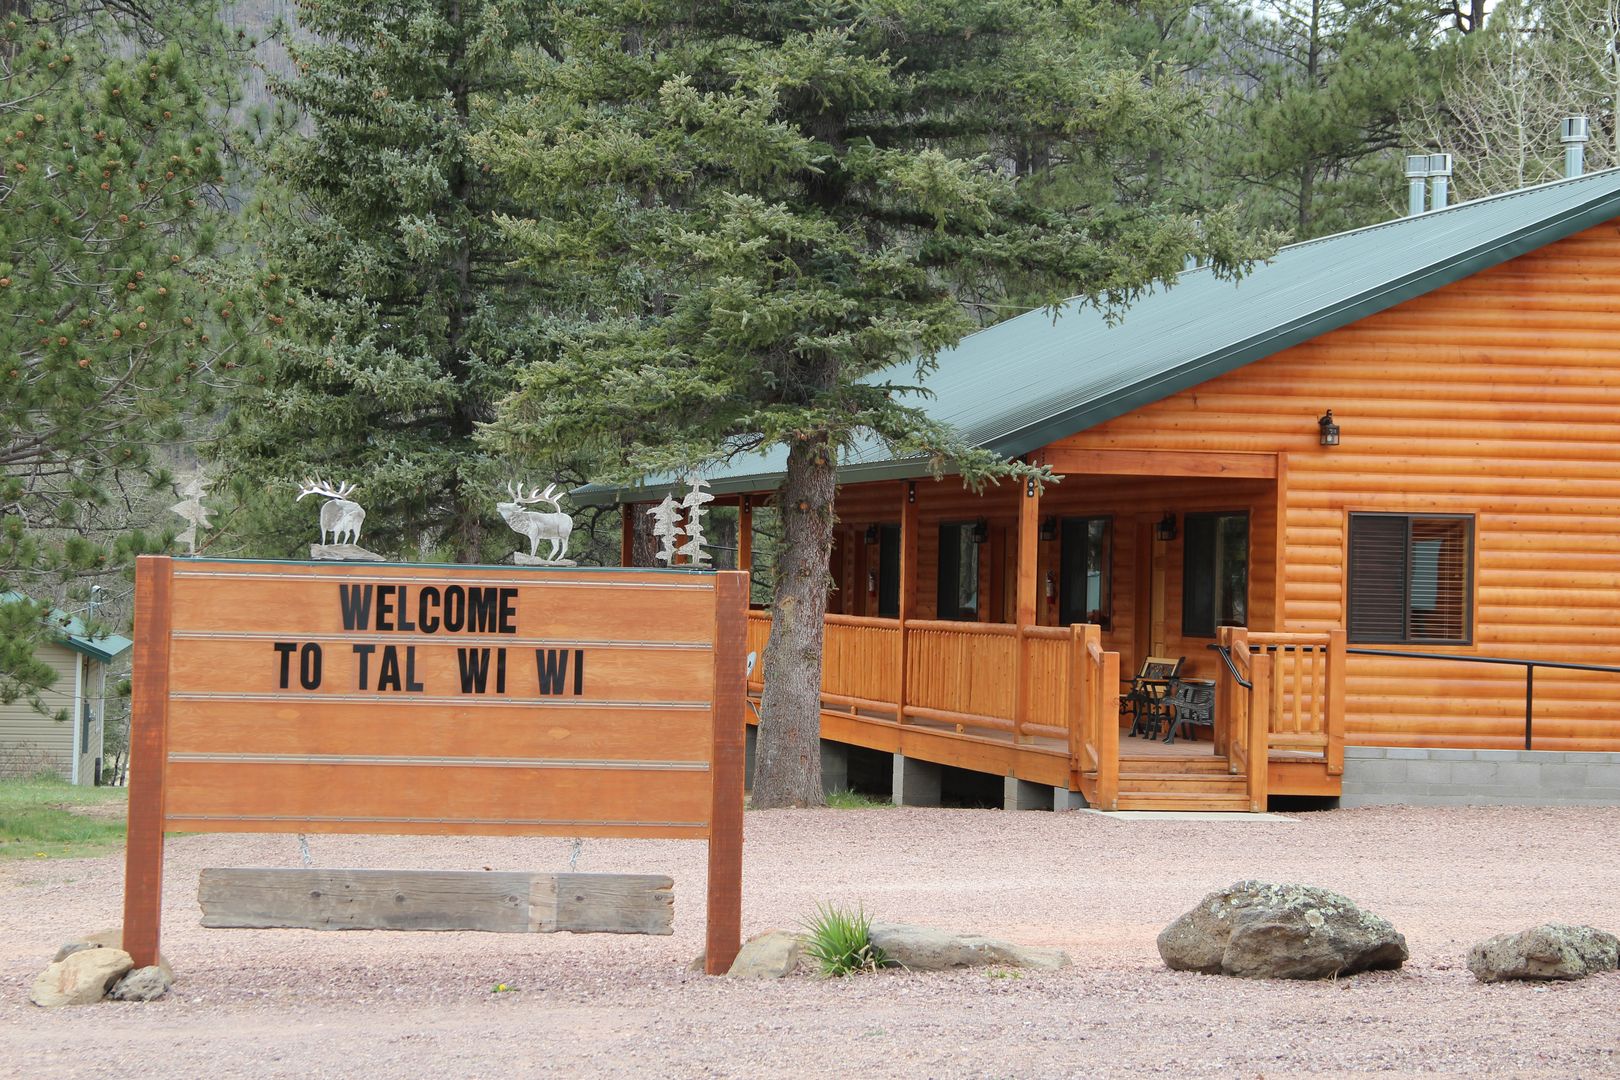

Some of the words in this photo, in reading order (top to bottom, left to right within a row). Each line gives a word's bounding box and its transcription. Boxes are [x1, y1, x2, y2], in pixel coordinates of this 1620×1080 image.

[339, 584, 519, 634] WELCOME
[274, 642, 323, 691] TO
[352, 644, 424, 692] TAL
[457, 647, 507, 694] WI
[535, 649, 584, 696] WI
